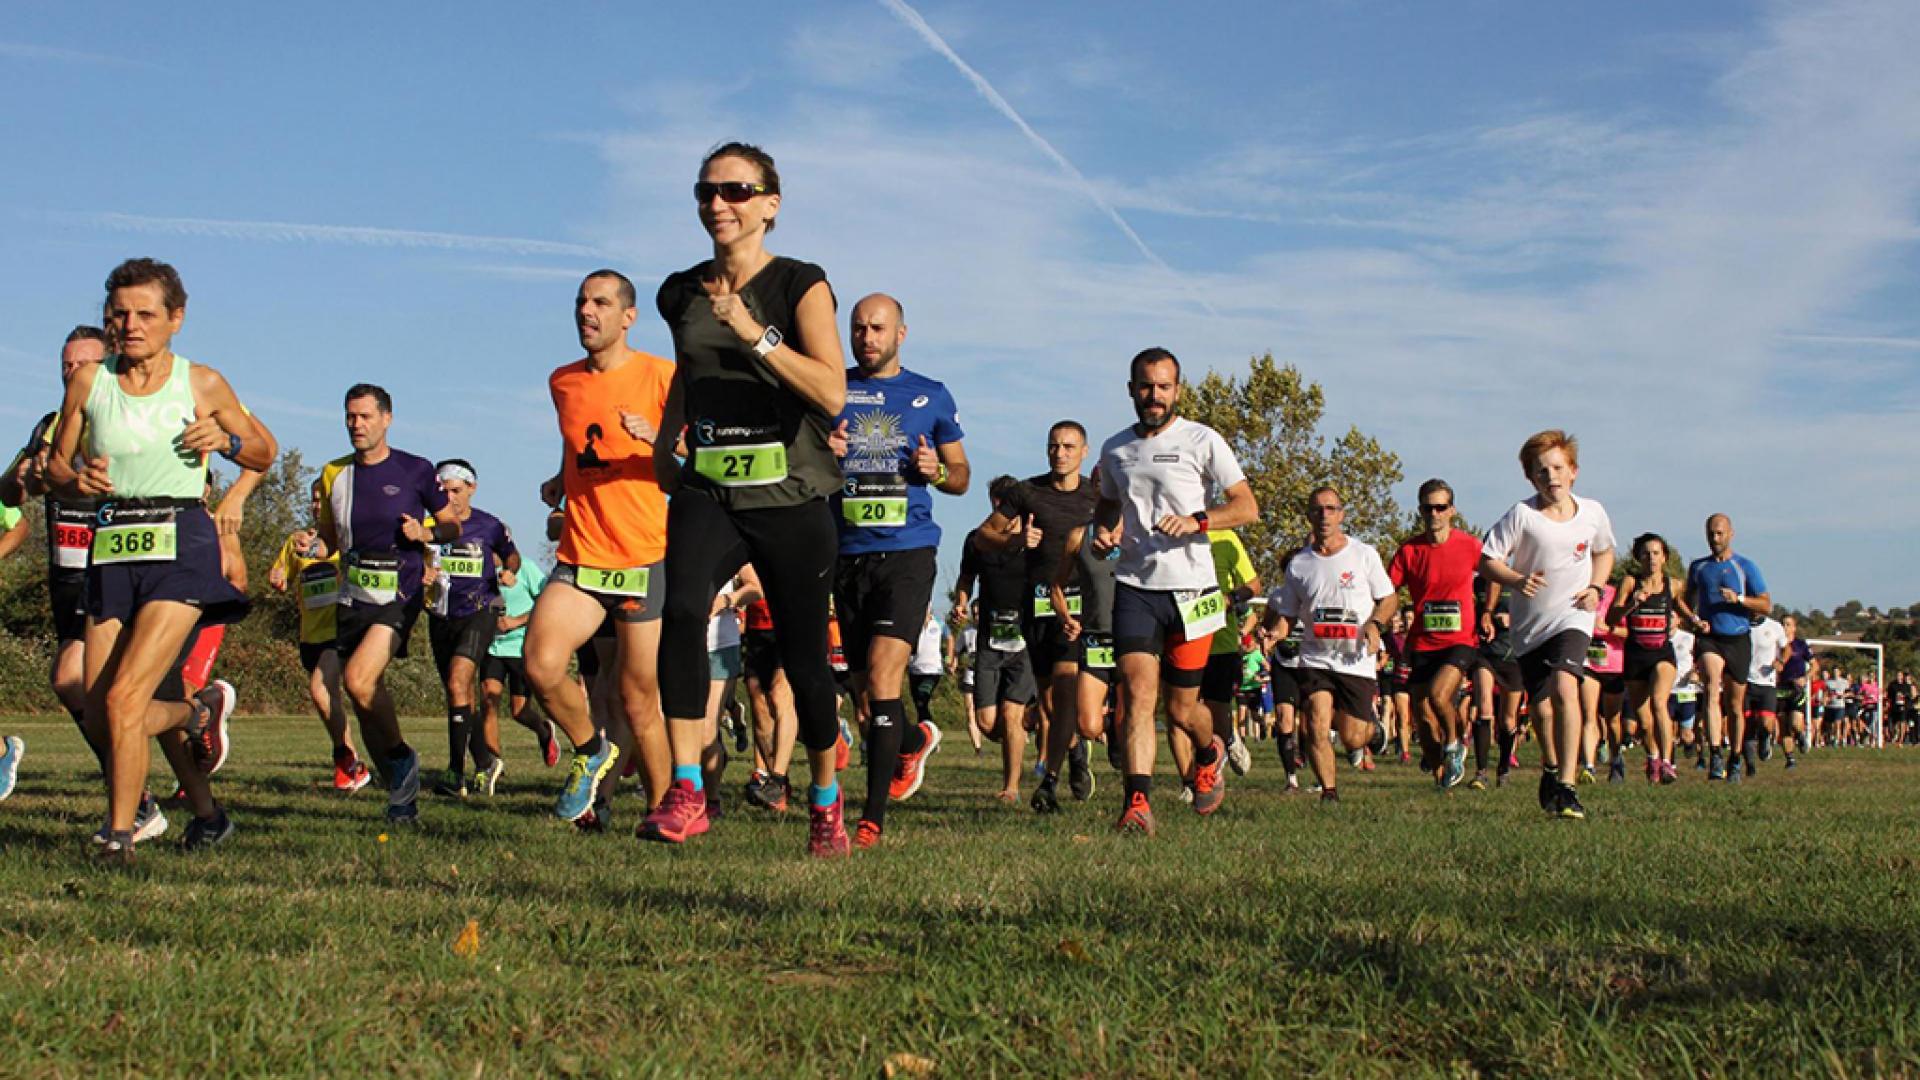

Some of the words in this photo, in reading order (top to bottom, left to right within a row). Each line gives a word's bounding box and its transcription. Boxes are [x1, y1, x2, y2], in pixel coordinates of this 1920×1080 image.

[723, 454, 755, 477] 27
[861, 503, 886, 520] 20
[56, 529, 89, 546] 868
[110, 531, 155, 554] 368
[449, 562, 474, 572] 108
[361, 573, 379, 588] 93
[600, 570, 625, 588] 70
[1193, 598, 1217, 617] 139
